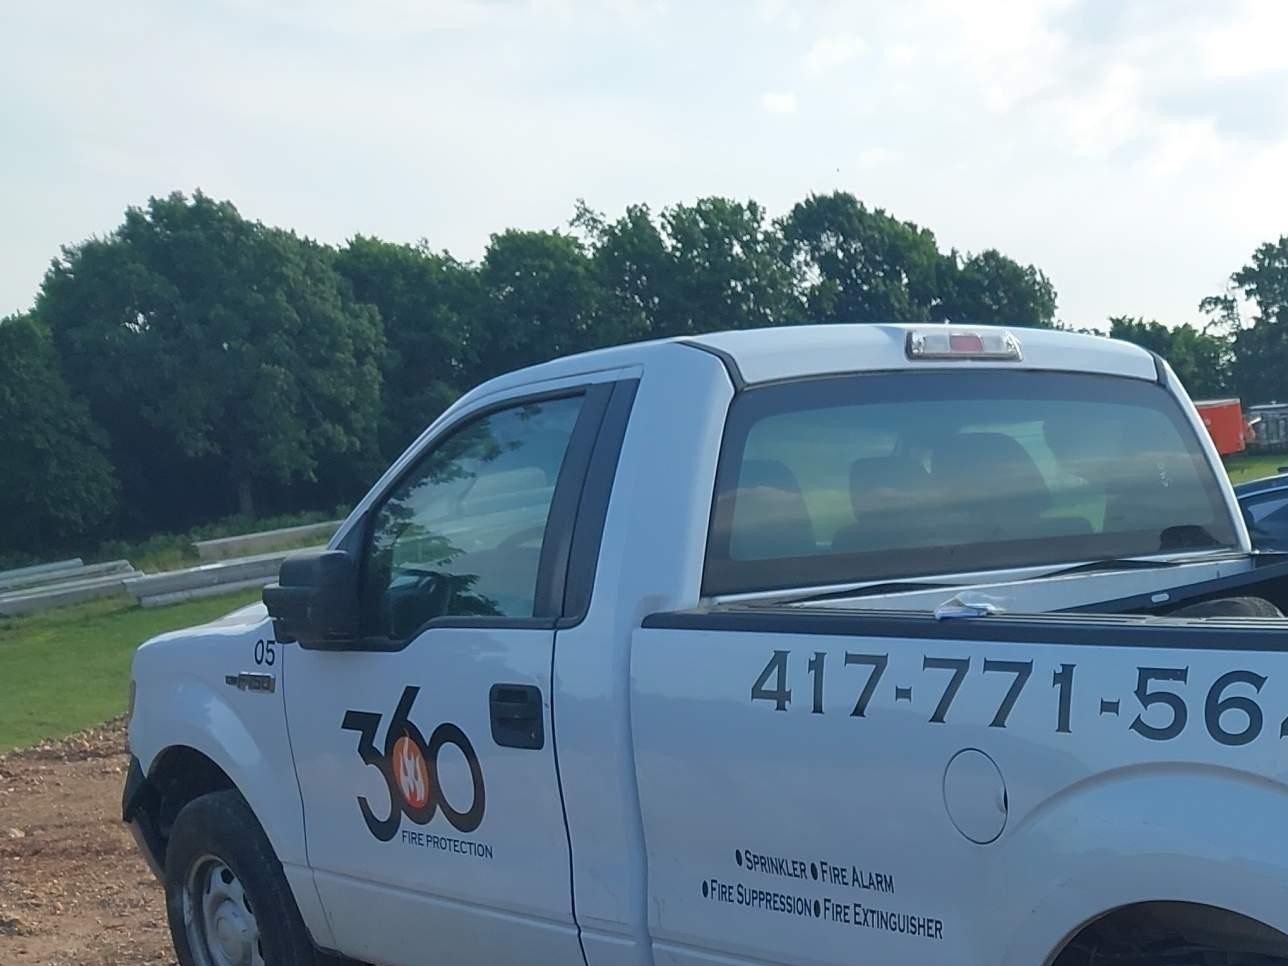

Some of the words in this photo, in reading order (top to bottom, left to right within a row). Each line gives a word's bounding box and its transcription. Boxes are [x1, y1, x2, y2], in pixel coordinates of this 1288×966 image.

[254, 639, 276, 666] 05
[341, 685, 486, 842] 360
[402, 830, 424, 847] FIRE
[425, 834, 493, 860] PROTECTION
